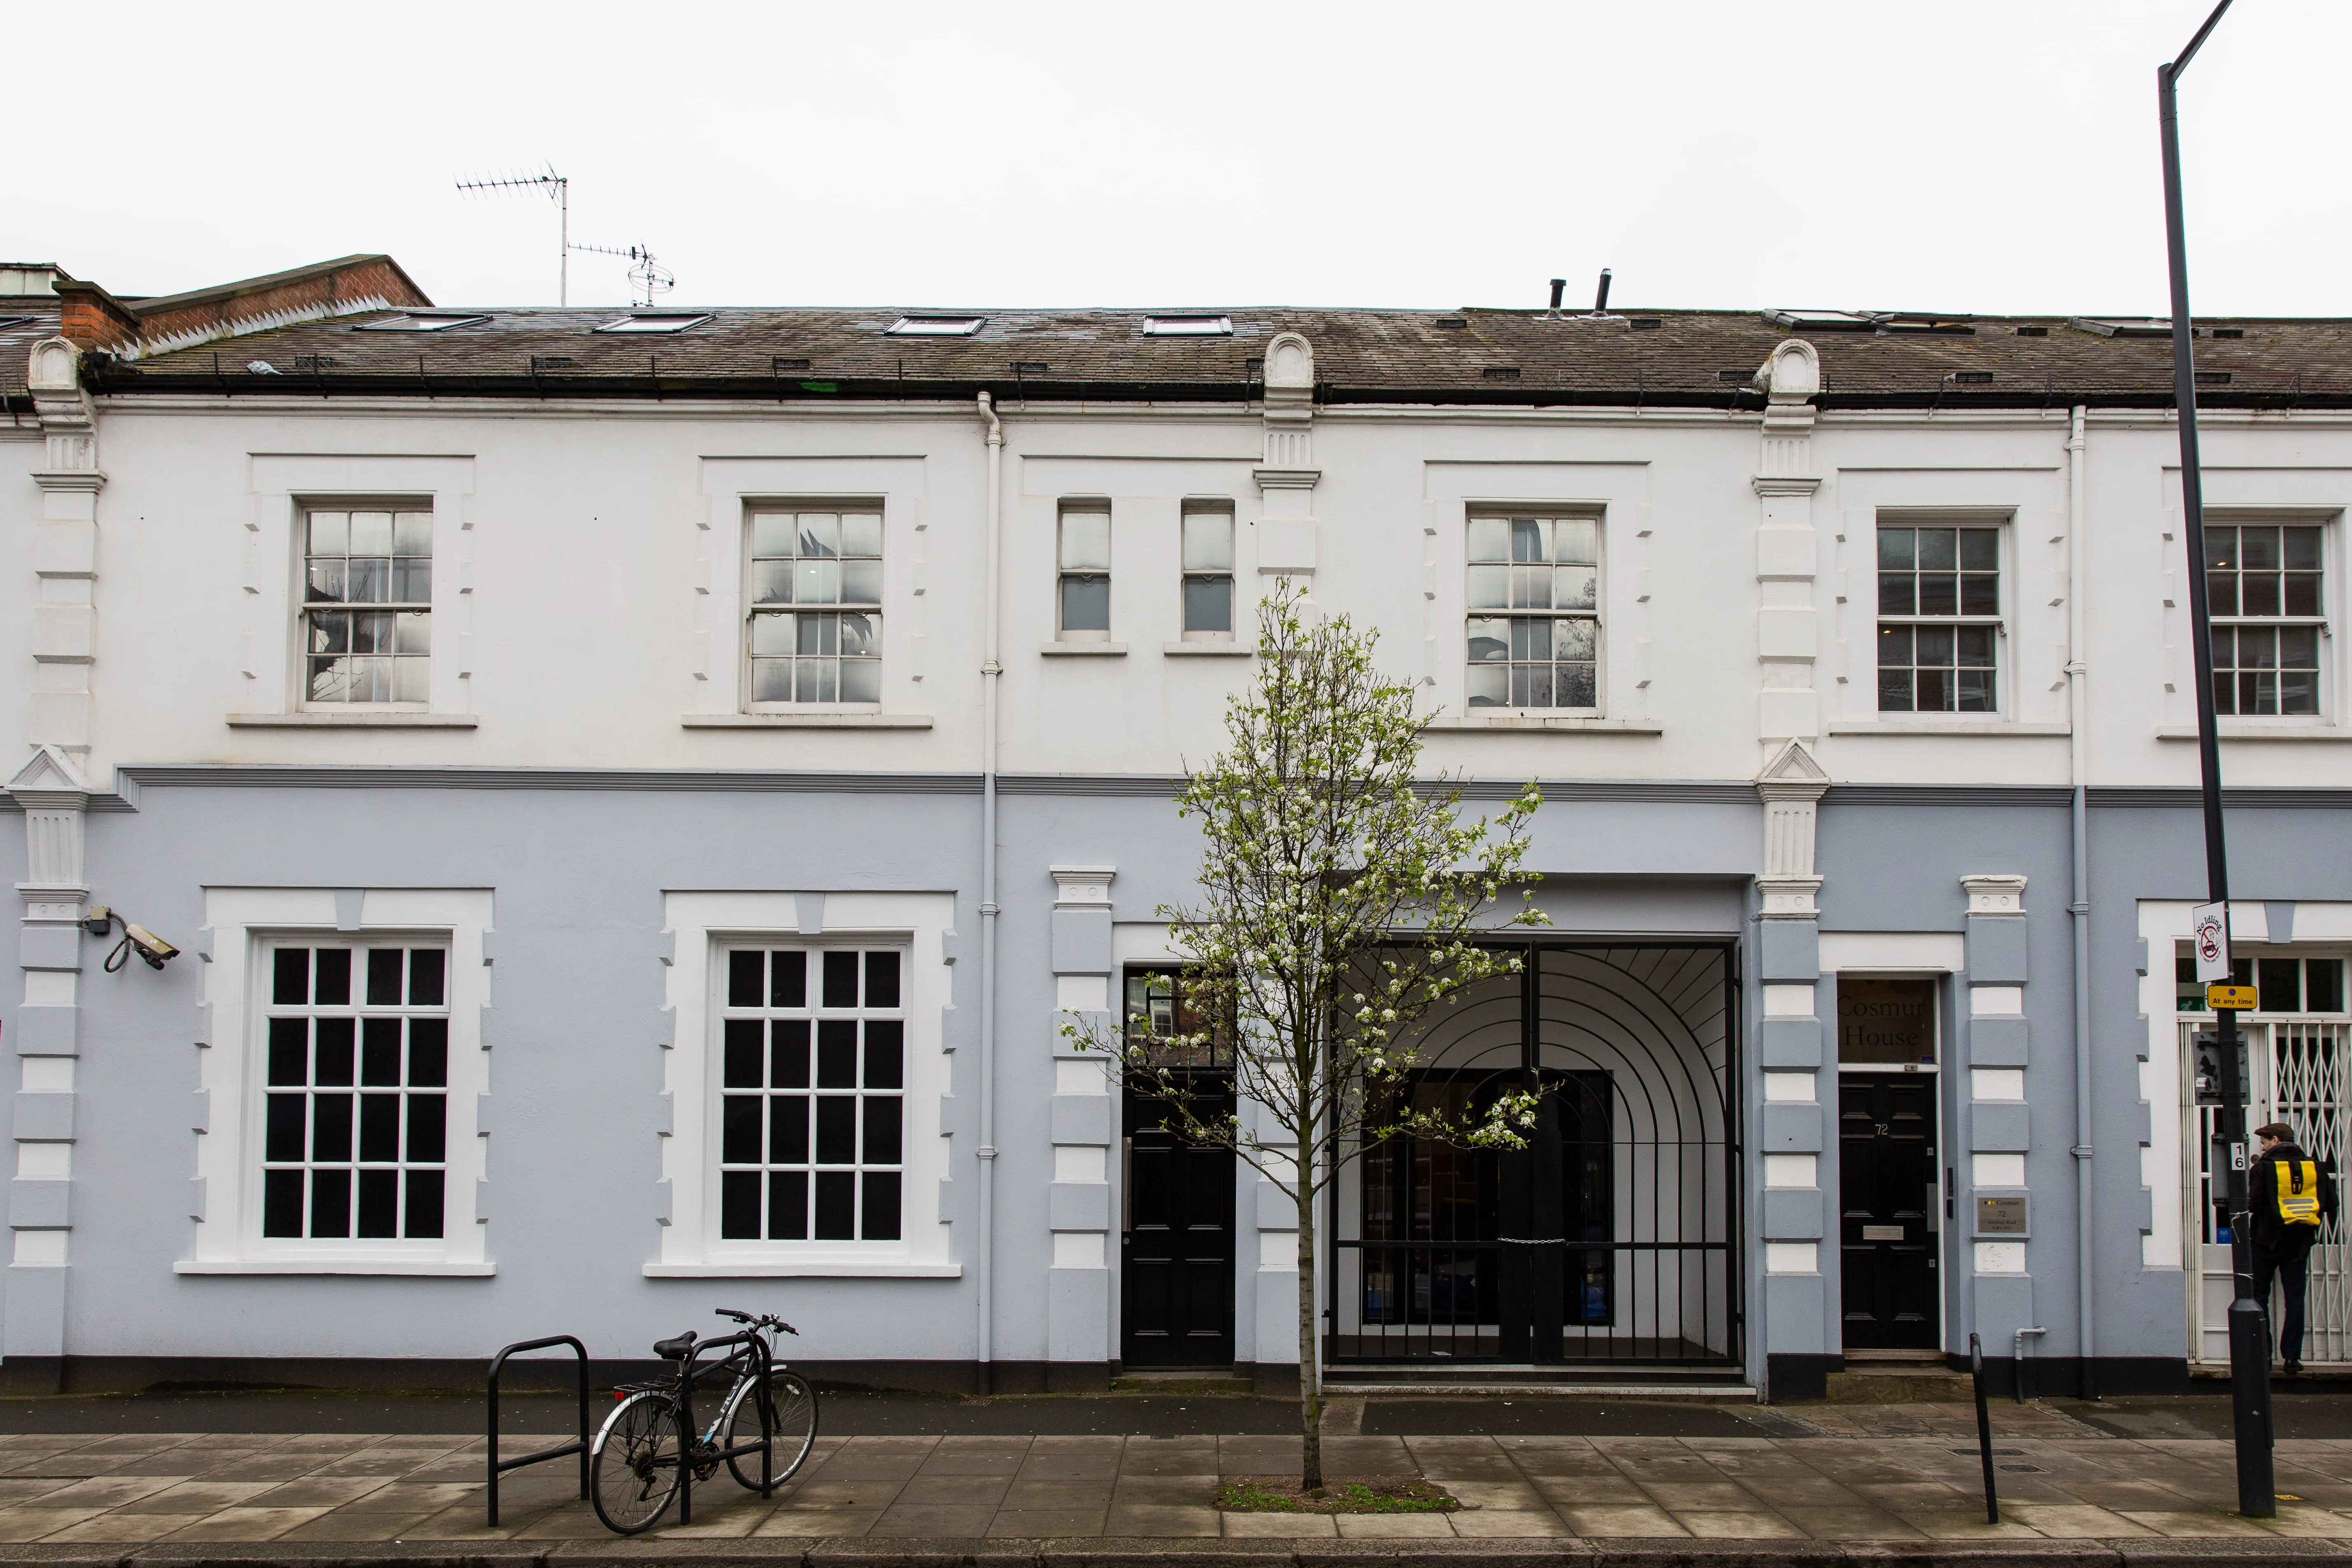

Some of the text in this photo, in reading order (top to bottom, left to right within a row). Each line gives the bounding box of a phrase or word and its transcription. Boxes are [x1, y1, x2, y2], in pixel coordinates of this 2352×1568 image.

[2196, 915, 2222, 935] No Idling
[1838, 996, 1924, 1016] Cosmur
[1845, 1025, 1918, 1046] House
[1875, 1124, 1888, 1135] 72
